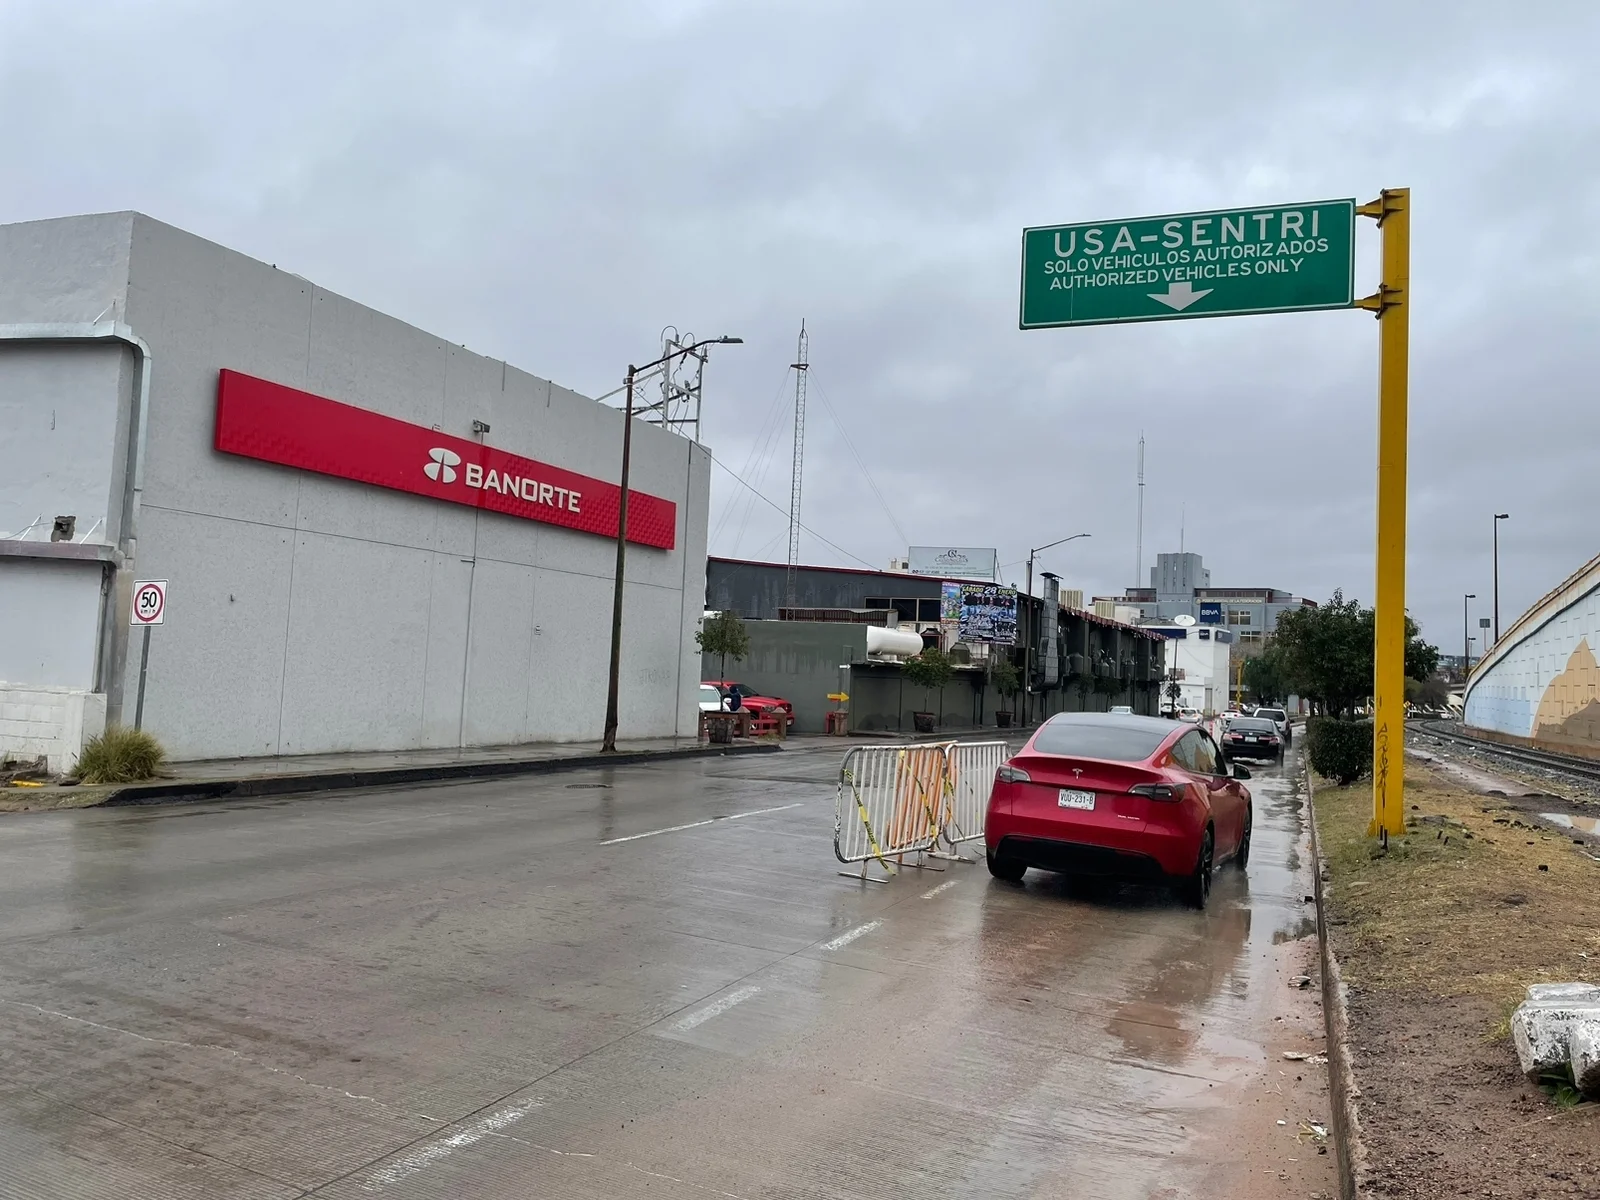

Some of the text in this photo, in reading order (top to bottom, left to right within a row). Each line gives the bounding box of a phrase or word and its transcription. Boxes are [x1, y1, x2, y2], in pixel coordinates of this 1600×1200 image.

[1054, 209, 1319, 257] USA-SENTRI
[1044, 238, 1329, 274] SOLO VEHICULOS AUTORIZADOS
[1050, 258, 1304, 290] AUTHORIZED VEHICLES ONLY
[465, 462, 582, 513] BANORTE
[141, 591, 157, 608] 50
[984, 586, 998, 595] 28
